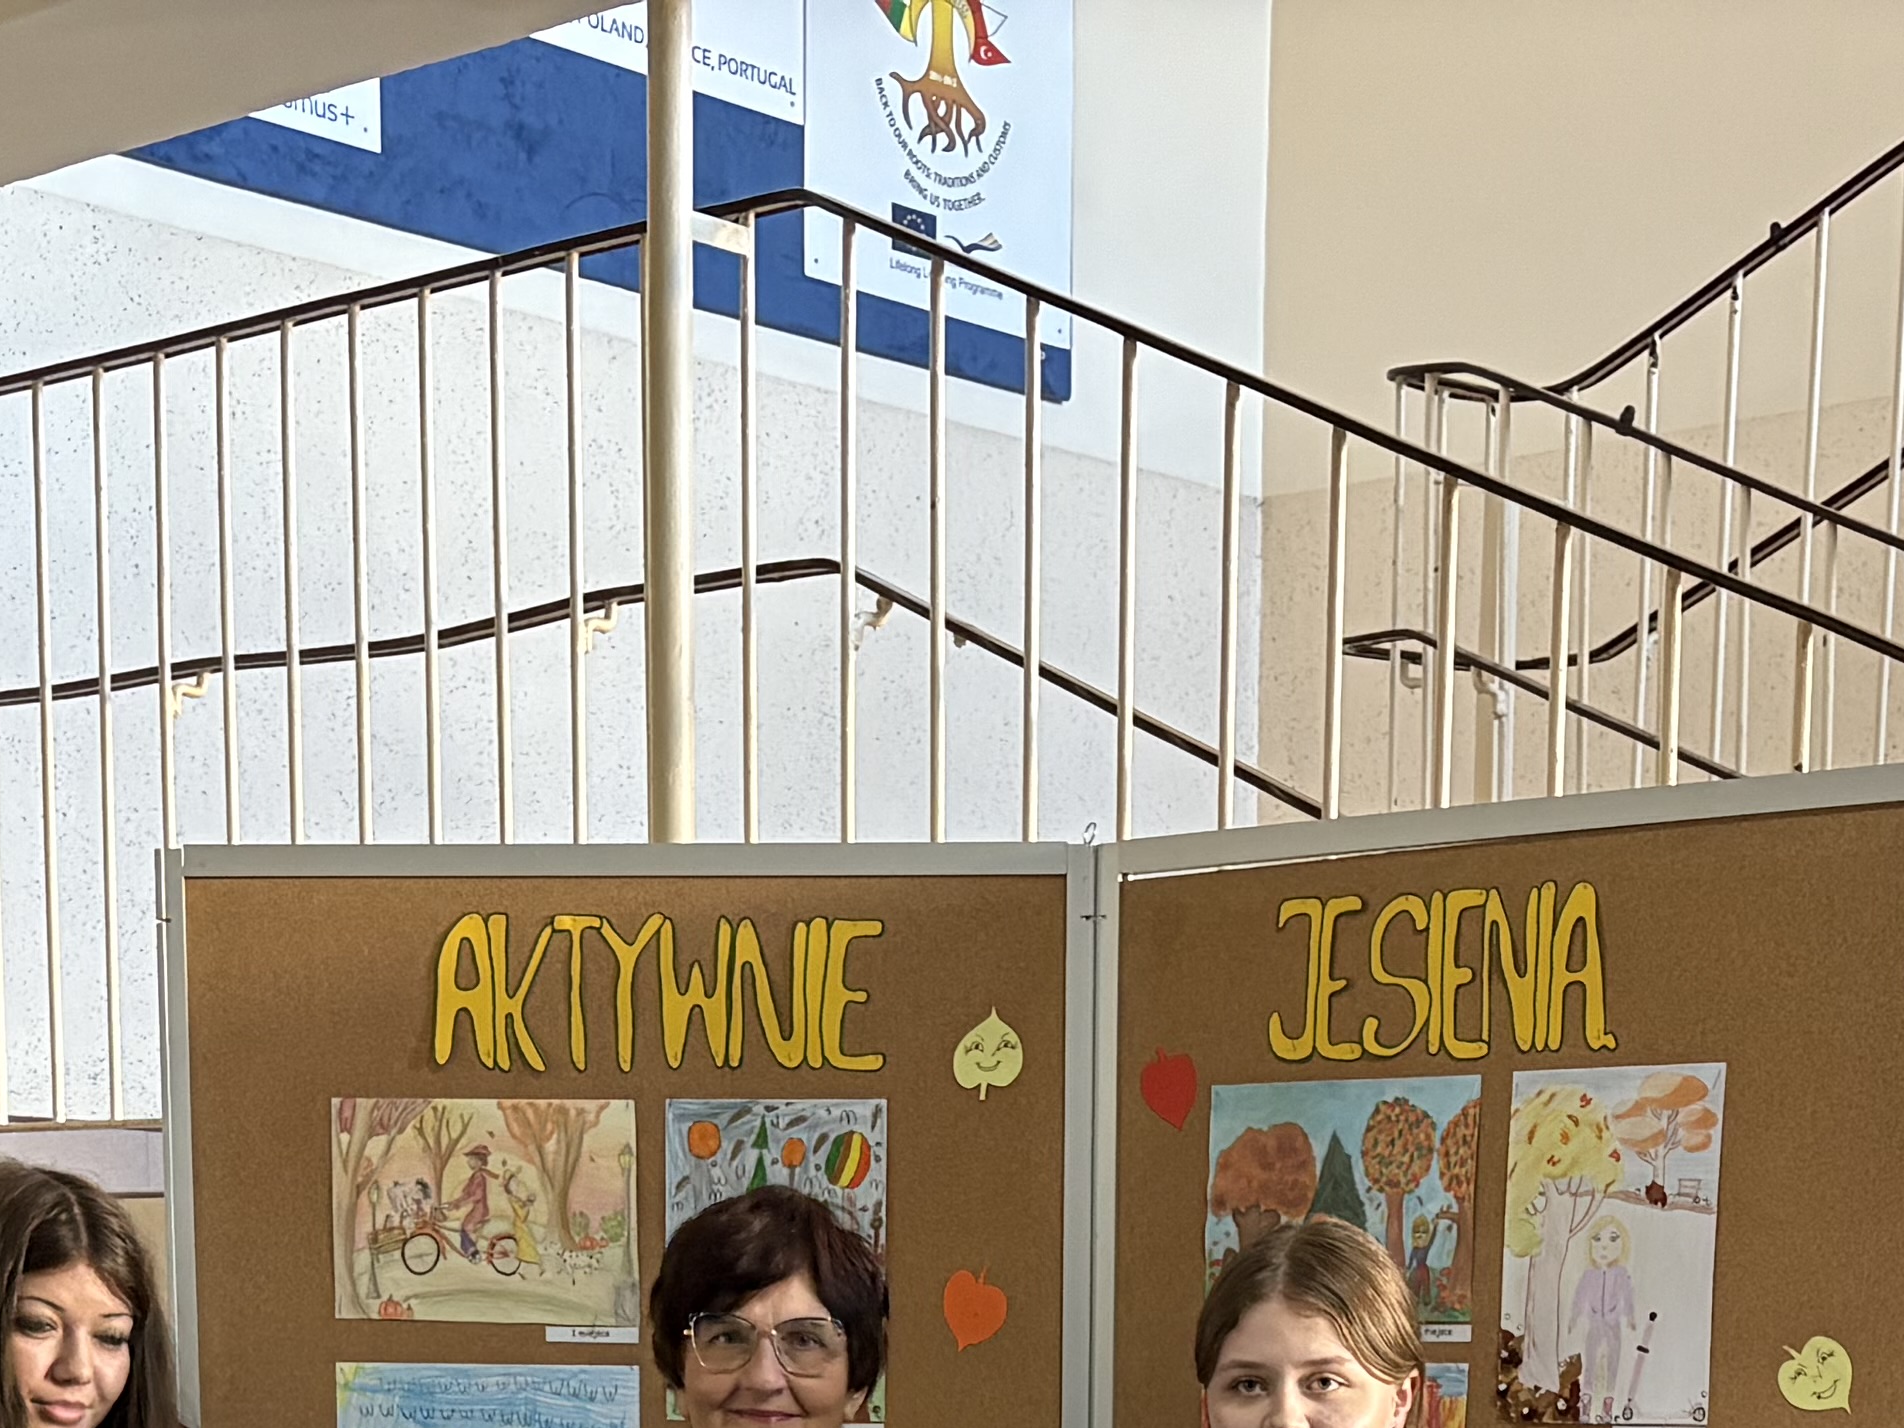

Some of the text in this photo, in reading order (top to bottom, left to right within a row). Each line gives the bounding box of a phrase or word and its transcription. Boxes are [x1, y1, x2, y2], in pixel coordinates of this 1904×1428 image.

[718, 53, 797, 95] PORTUGAL
[875, 78, 890, 110] BACK
[886, 110, 896, 127] TO
[433, 910, 889, 1075] AKTYWNIE
